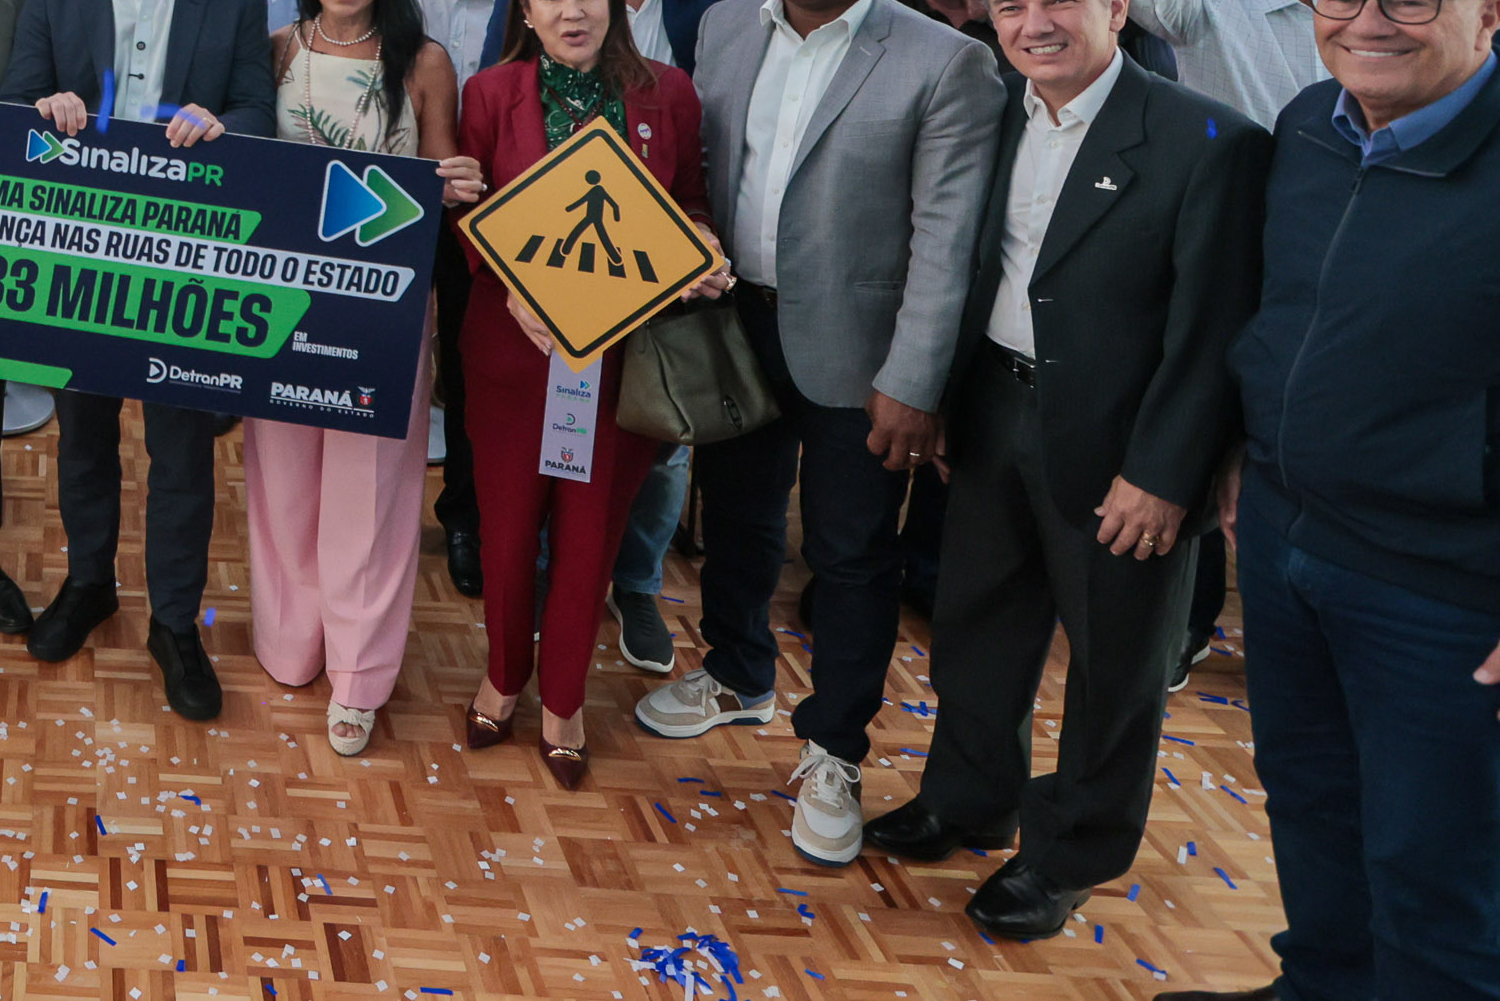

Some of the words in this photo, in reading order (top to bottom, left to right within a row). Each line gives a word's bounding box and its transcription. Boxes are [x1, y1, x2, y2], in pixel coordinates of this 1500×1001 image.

[29, 185, 137, 225] SINALIZA
[142, 201, 242, 240] PARANÁ
[50, 223, 100, 254] NAS
[104, 230, 171, 264] RUAS
[175, 244, 206, 270] DE
[213, 248, 277, 281] TODO
[280, 257, 299, 283] O
[302, 260, 400, 297] ESTADO
[45, 264, 273, 348] MILHÕES
[294, 331, 308, 343] EM
[292, 341, 359, 360] INVESTIMENTOS
[169, 365, 243, 389] DetranPR
[271, 382, 353, 407] PARANÁ
[556, 385, 591, 398] Sinaliza
[269, 399, 314, 410] GOVERNO
[338, 409, 375, 418] ESTADO
[545, 460, 586, 474] PARANÁ
